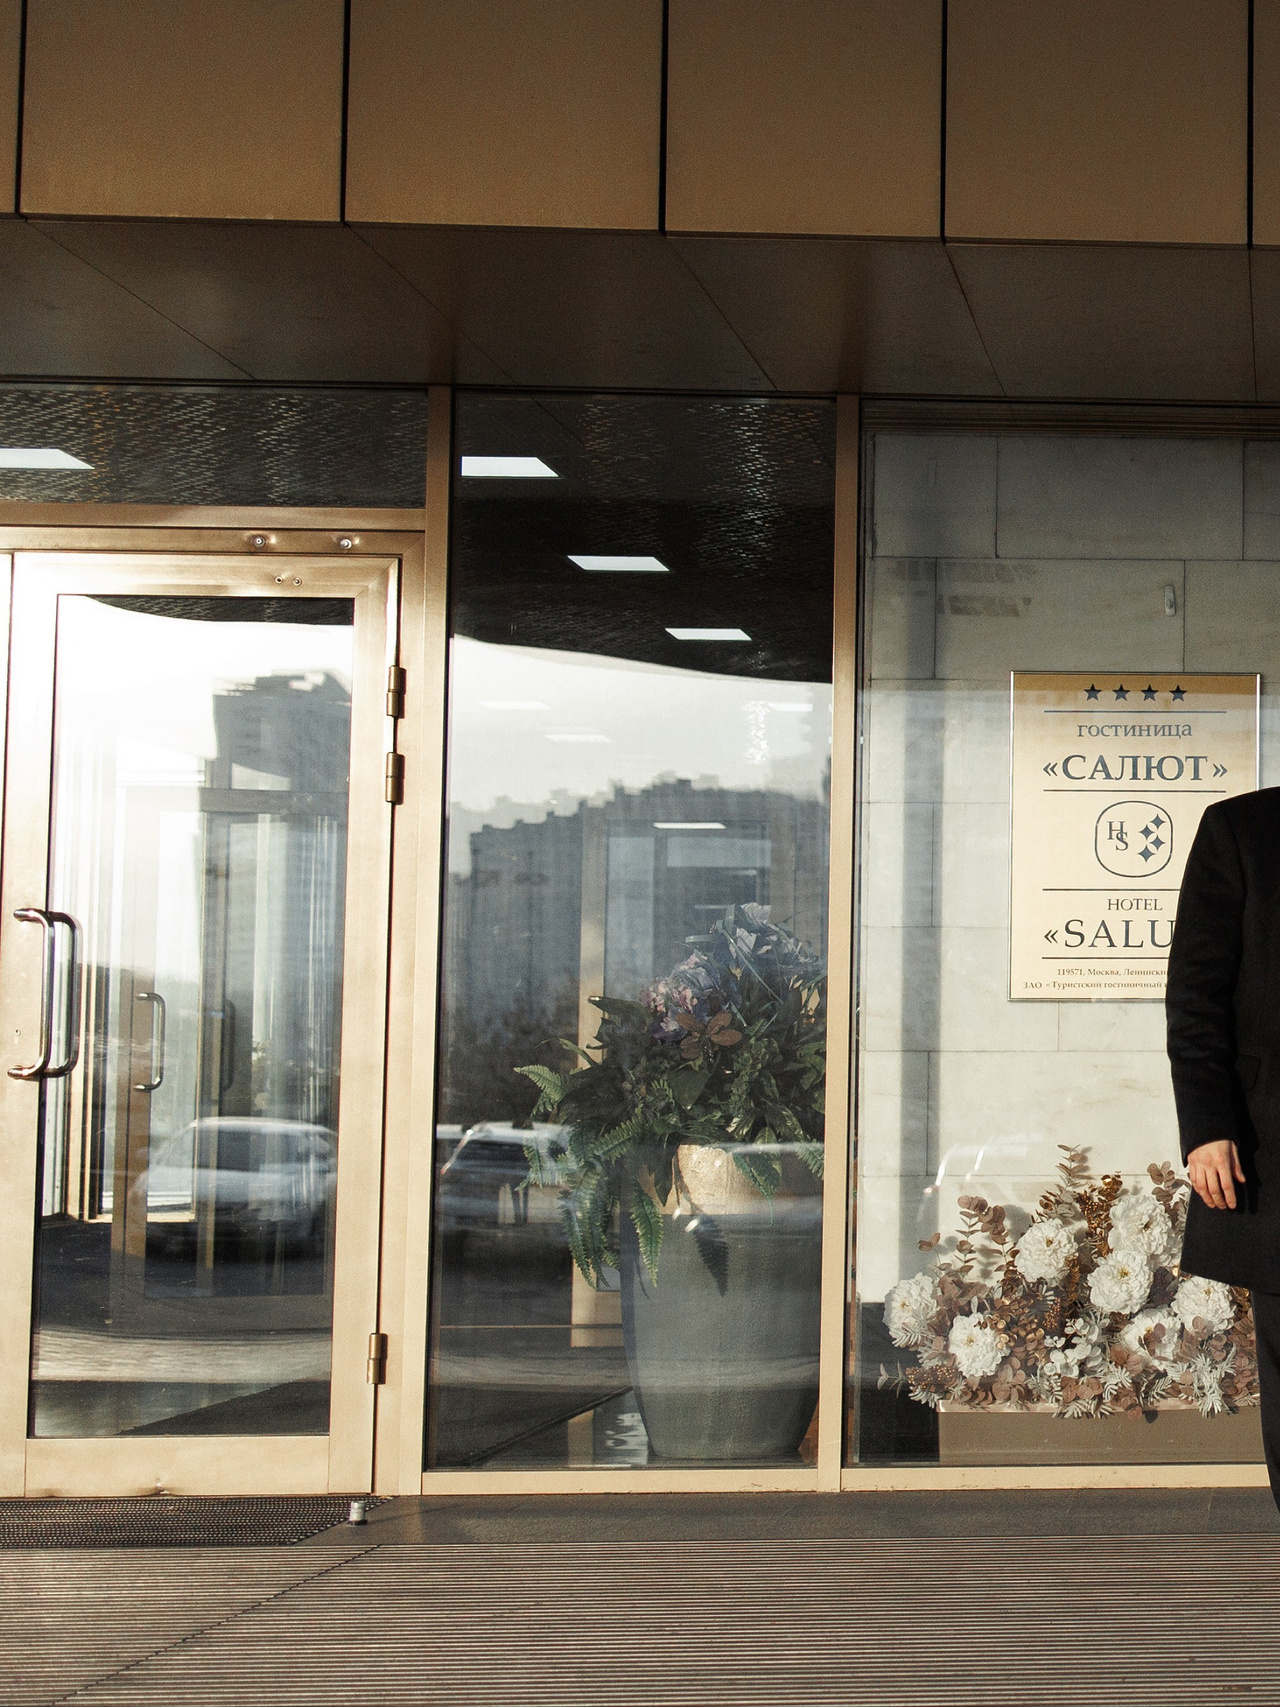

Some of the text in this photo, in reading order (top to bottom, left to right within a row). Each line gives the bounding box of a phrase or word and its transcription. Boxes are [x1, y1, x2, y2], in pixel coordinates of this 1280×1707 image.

[1077, 723, 1192, 739] гостиница
[1042, 754, 1228, 781] «САЛЮТ»
[1107, 898, 1163, 911] HOTEL
[1044, 919, 1176, 948] «SALU
[1057, 968, 1168, 977] 119571, Москва, Ленински
[1023, 981, 1043, 989] ЗАО
